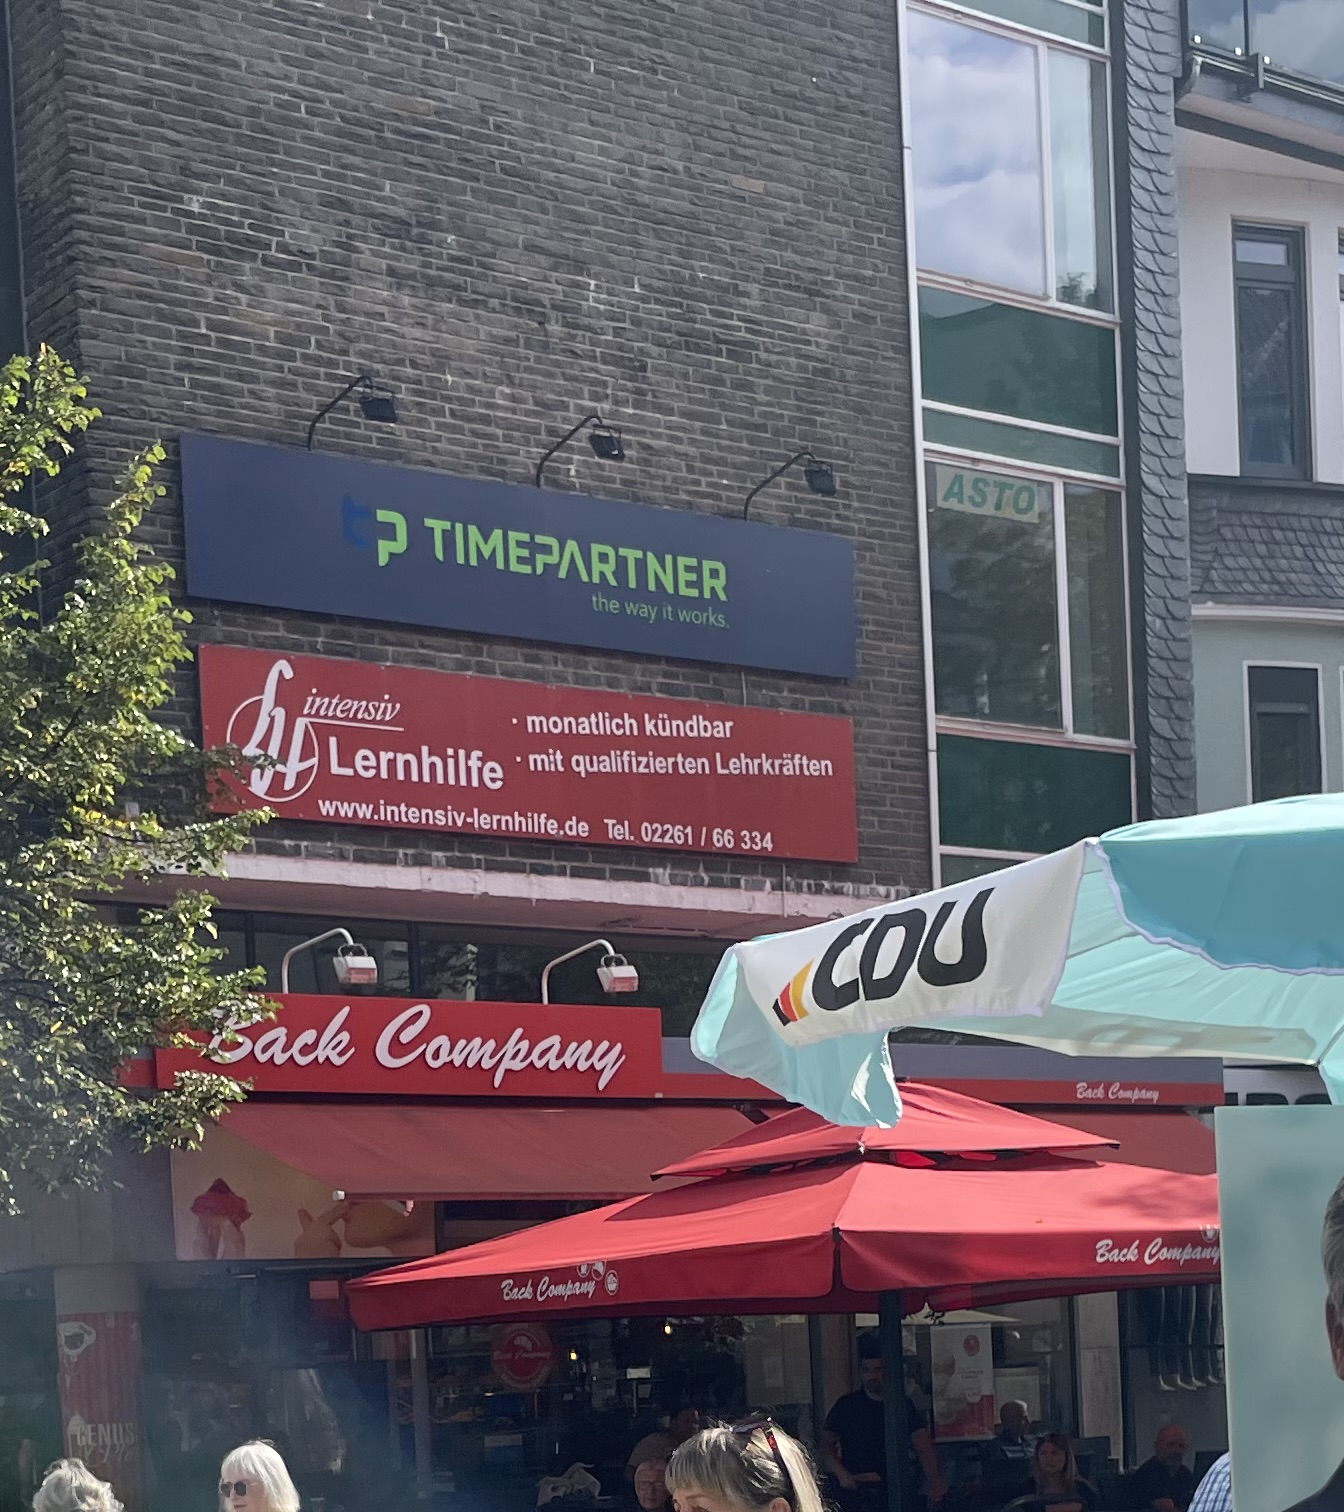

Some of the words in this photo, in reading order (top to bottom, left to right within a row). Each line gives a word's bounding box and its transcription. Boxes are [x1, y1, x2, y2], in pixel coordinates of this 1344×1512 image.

[942, 474, 1036, 515] ASTO
[424, 517, 728, 601] TIMEPARTNER
[592, 591, 619, 614] the
[625, 602, 657, 624] way
[662, 603, 674, 621] it
[677, 607, 730, 628] works.
[303, 688, 401, 721] intensiv
[526, 711, 638, 736] monatlich
[644, 713, 734, 738] kündbar
[329, 736, 504, 790] Lernhilfe
[529, 749, 564, 772] mit
[571, 750, 709, 778] qualifizierten
[715, 752, 833, 776] Lehrkräften
[318, 799, 589, 838] www.intensiv-lernhilfe.de
[604, 818, 635, 841] Tel.
[641, 822, 693, 846] 02261
[712, 828, 735, 849] 66
[740, 831, 774, 852] 334
[812, 887, 995, 1011] CDU
[209, 1001, 355, 1067] Back
[375, 1004, 625, 1091] Company
[1076, 1082, 1104, 1099] Back
[1108, 1082, 1159, 1103] Company
[1095, 1238, 1139, 1263] Back
[1144, 1237, 1221, 1265] Company
[501, 1279, 533, 1300] Back
[537, 1276, 595, 1301] Company
